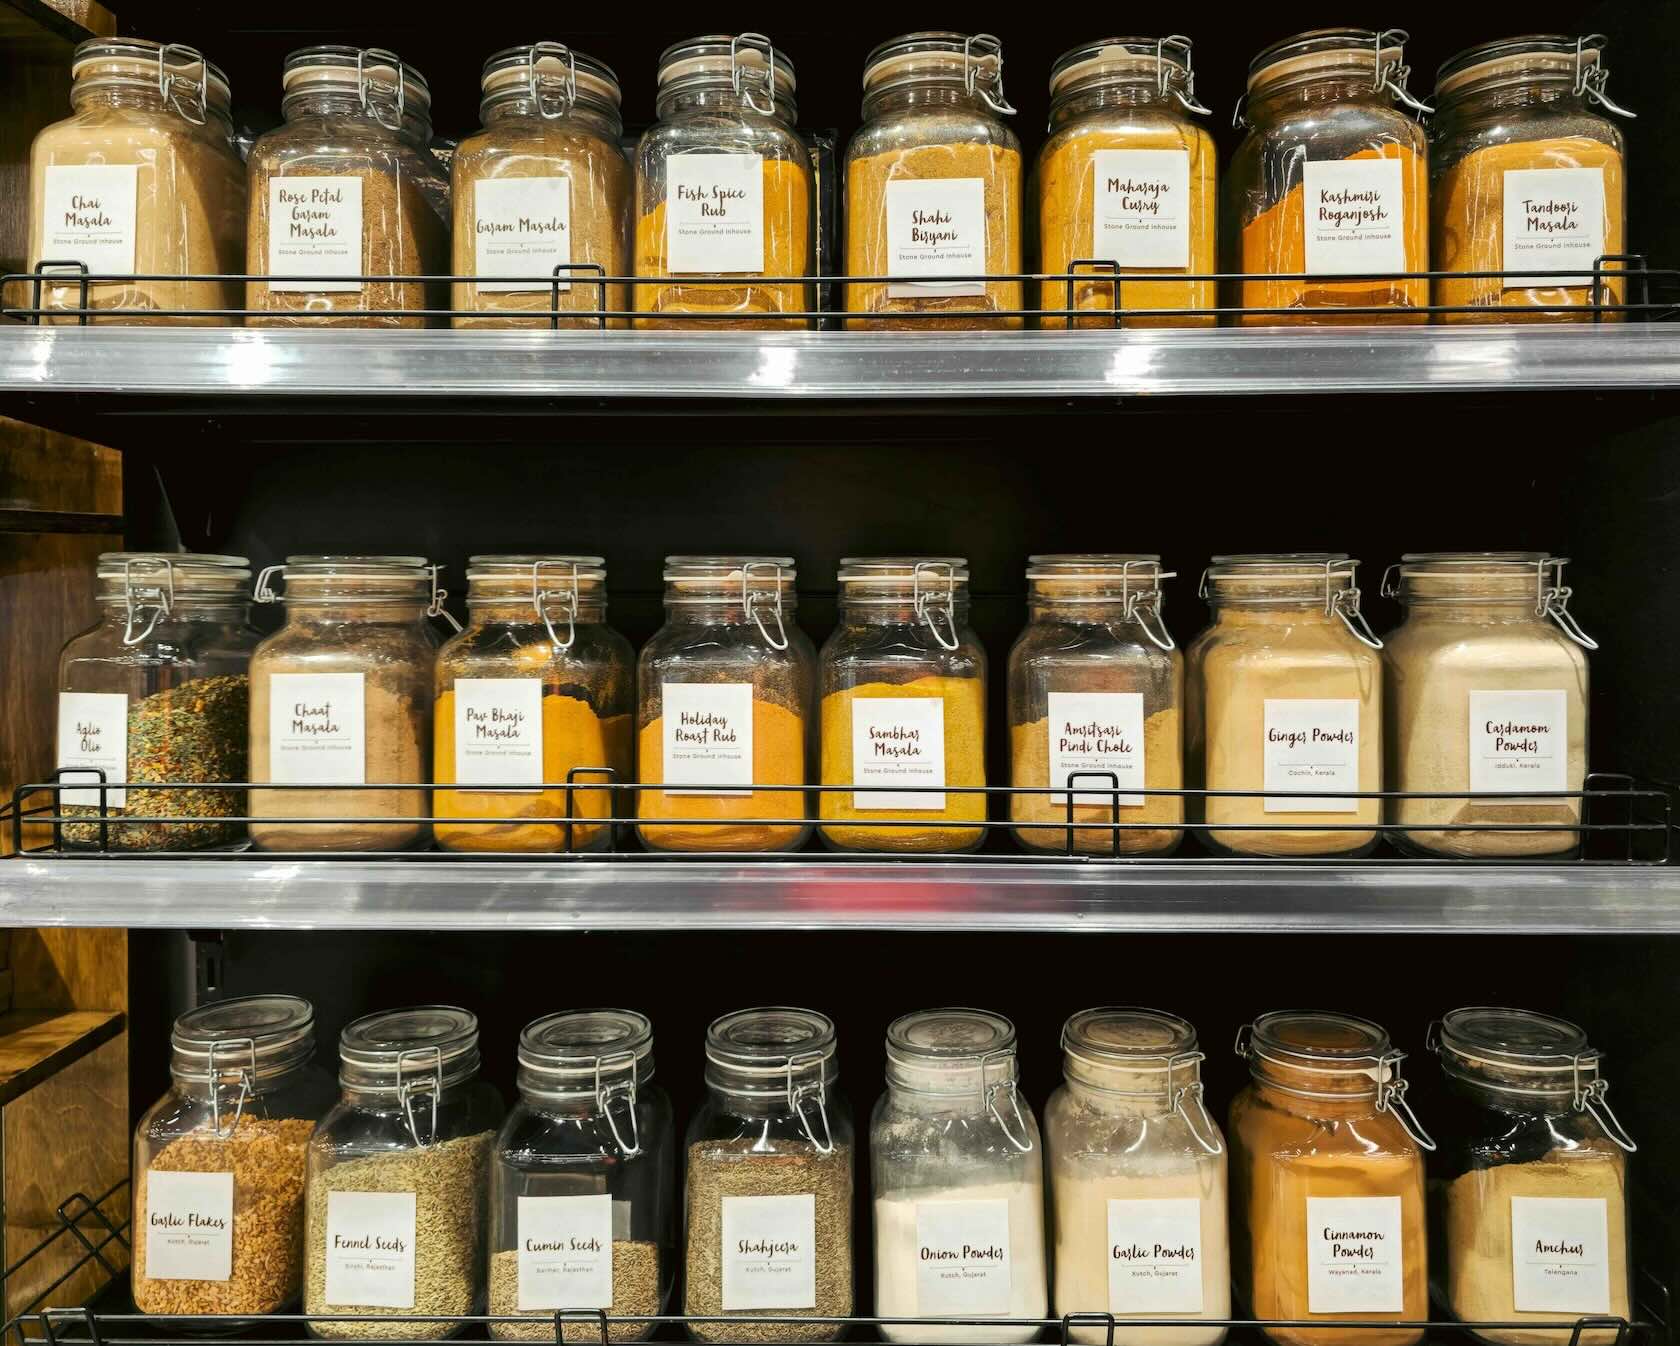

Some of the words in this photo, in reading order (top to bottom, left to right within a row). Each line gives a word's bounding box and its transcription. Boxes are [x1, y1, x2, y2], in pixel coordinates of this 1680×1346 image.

[279, 189, 307, 203] Rose
[311, 188, 343, 205] Petal
[677, 185, 708, 201] Fish
[712, 185, 746, 206] Spice
[1107, 178, 1170, 199] Maharaja
[71, 195, 102, 210] Chai
[1122, 196, 1160, 215] Curry
[1321, 189, 1381, 206] Kashmiri
[292, 206, 330, 222] Garam
[701, 202, 727, 217] Rub
[1522, 199, 1579, 215] Tandoori
[64, 212, 112, 229] Masala
[911, 209, 952, 225] Shahi
[1319, 205, 1388, 227] Roganjosh
[1527, 216, 1578, 233] Masala
[290, 223, 337, 240] Masala
[477, 219, 515, 235] Garam
[519, 216, 567, 235] Masala
[911, 227, 958, 246] Biryani
[1316, 234, 1336, 242] Stone
[1364, 233, 1392, 241] Inhouse
[1536, 242, 1562, 250] Ground
[899, 253, 918, 261] Stone
[295, 701, 331, 717] Chaat
[466, 707, 489, 723] Pav
[491, 706, 525, 727] Bhaji
[292, 719, 340, 736] Masala
[680, 712, 728, 730] Holiday
[1486, 720, 1550, 736] Cardamom
[476, 724, 520, 740] Masala
[675, 728, 710, 744] Roast
[713, 728, 737, 743] Rub
[869, 726, 920, 742] Sambhar
[1064, 722, 1123, 738] Amritsari
[1268, 727, 1308, 749] Ginger
[1312, 727, 1354, 746] Powder
[80, 737, 102, 753] Olio
[874, 742, 922, 758] Masala
[1059, 738, 1093, 753] Pindi
[1097, 738, 1133, 753] Chole
[1495, 737, 1538, 754] Powder
[151, 1211, 185, 1230] Garlic
[188, 1213, 226, 1230] Flakes
[1323, 1227, 1385, 1241] Cinnamon
[334, 1234, 373, 1250] Fennel
[375, 1235, 408, 1253] Seeds
[526, 1238, 564, 1253] Cumin
[570, 1237, 603, 1253] Seeds
[738, 1239, 799, 1258] Shahjeera
[1333, 1244, 1374, 1260] Powder
[1535, 1240, 1584, 1257] Amchur
[920, 1246, 960, 1261] Onion
[963, 1244, 1004, 1262] Powder
[1112, 1244, 1150, 1261] Garlic
[1153, 1244, 1195, 1261] Powder
